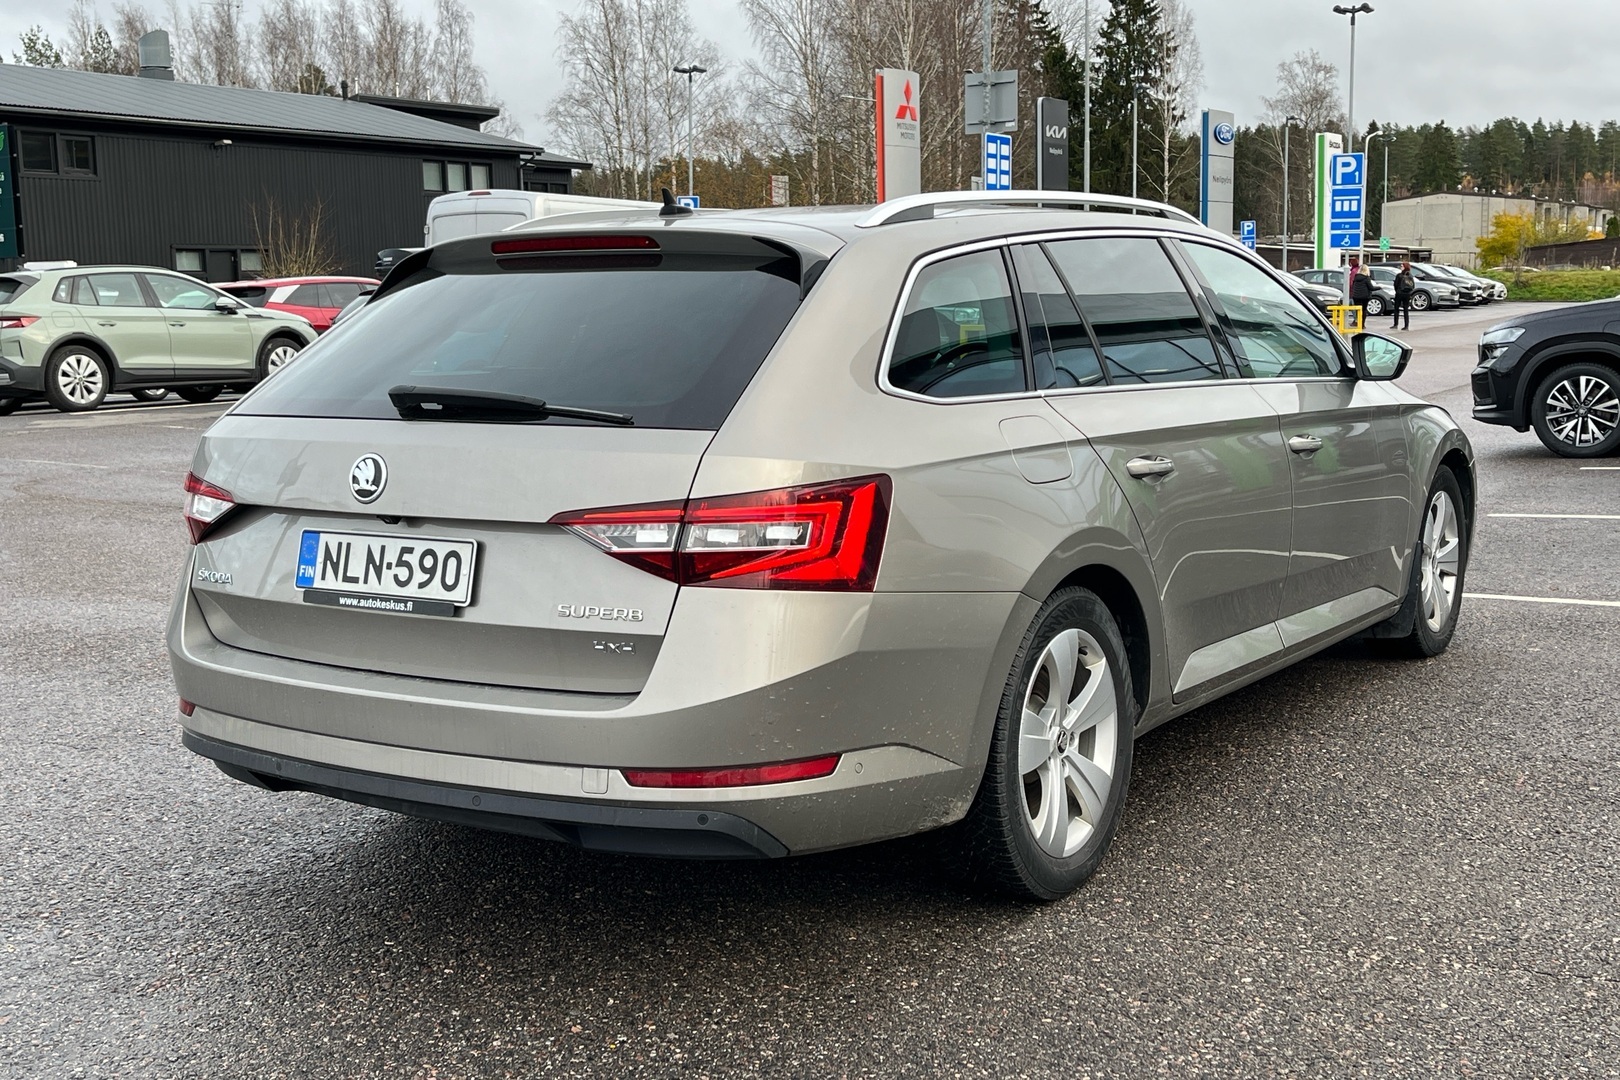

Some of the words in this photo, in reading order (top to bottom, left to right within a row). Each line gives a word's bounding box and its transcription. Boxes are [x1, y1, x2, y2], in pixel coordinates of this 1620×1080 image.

[1243, 222, 1254, 235] P
[299, 565, 315, 578] FIN
[320, 541, 463, 592] NLN-590
[198, 567, 233, 585] ŠKODA
[339, 596, 413, 612] www.autokeskus.fi
[557, 604, 644, 622] SUPERB
